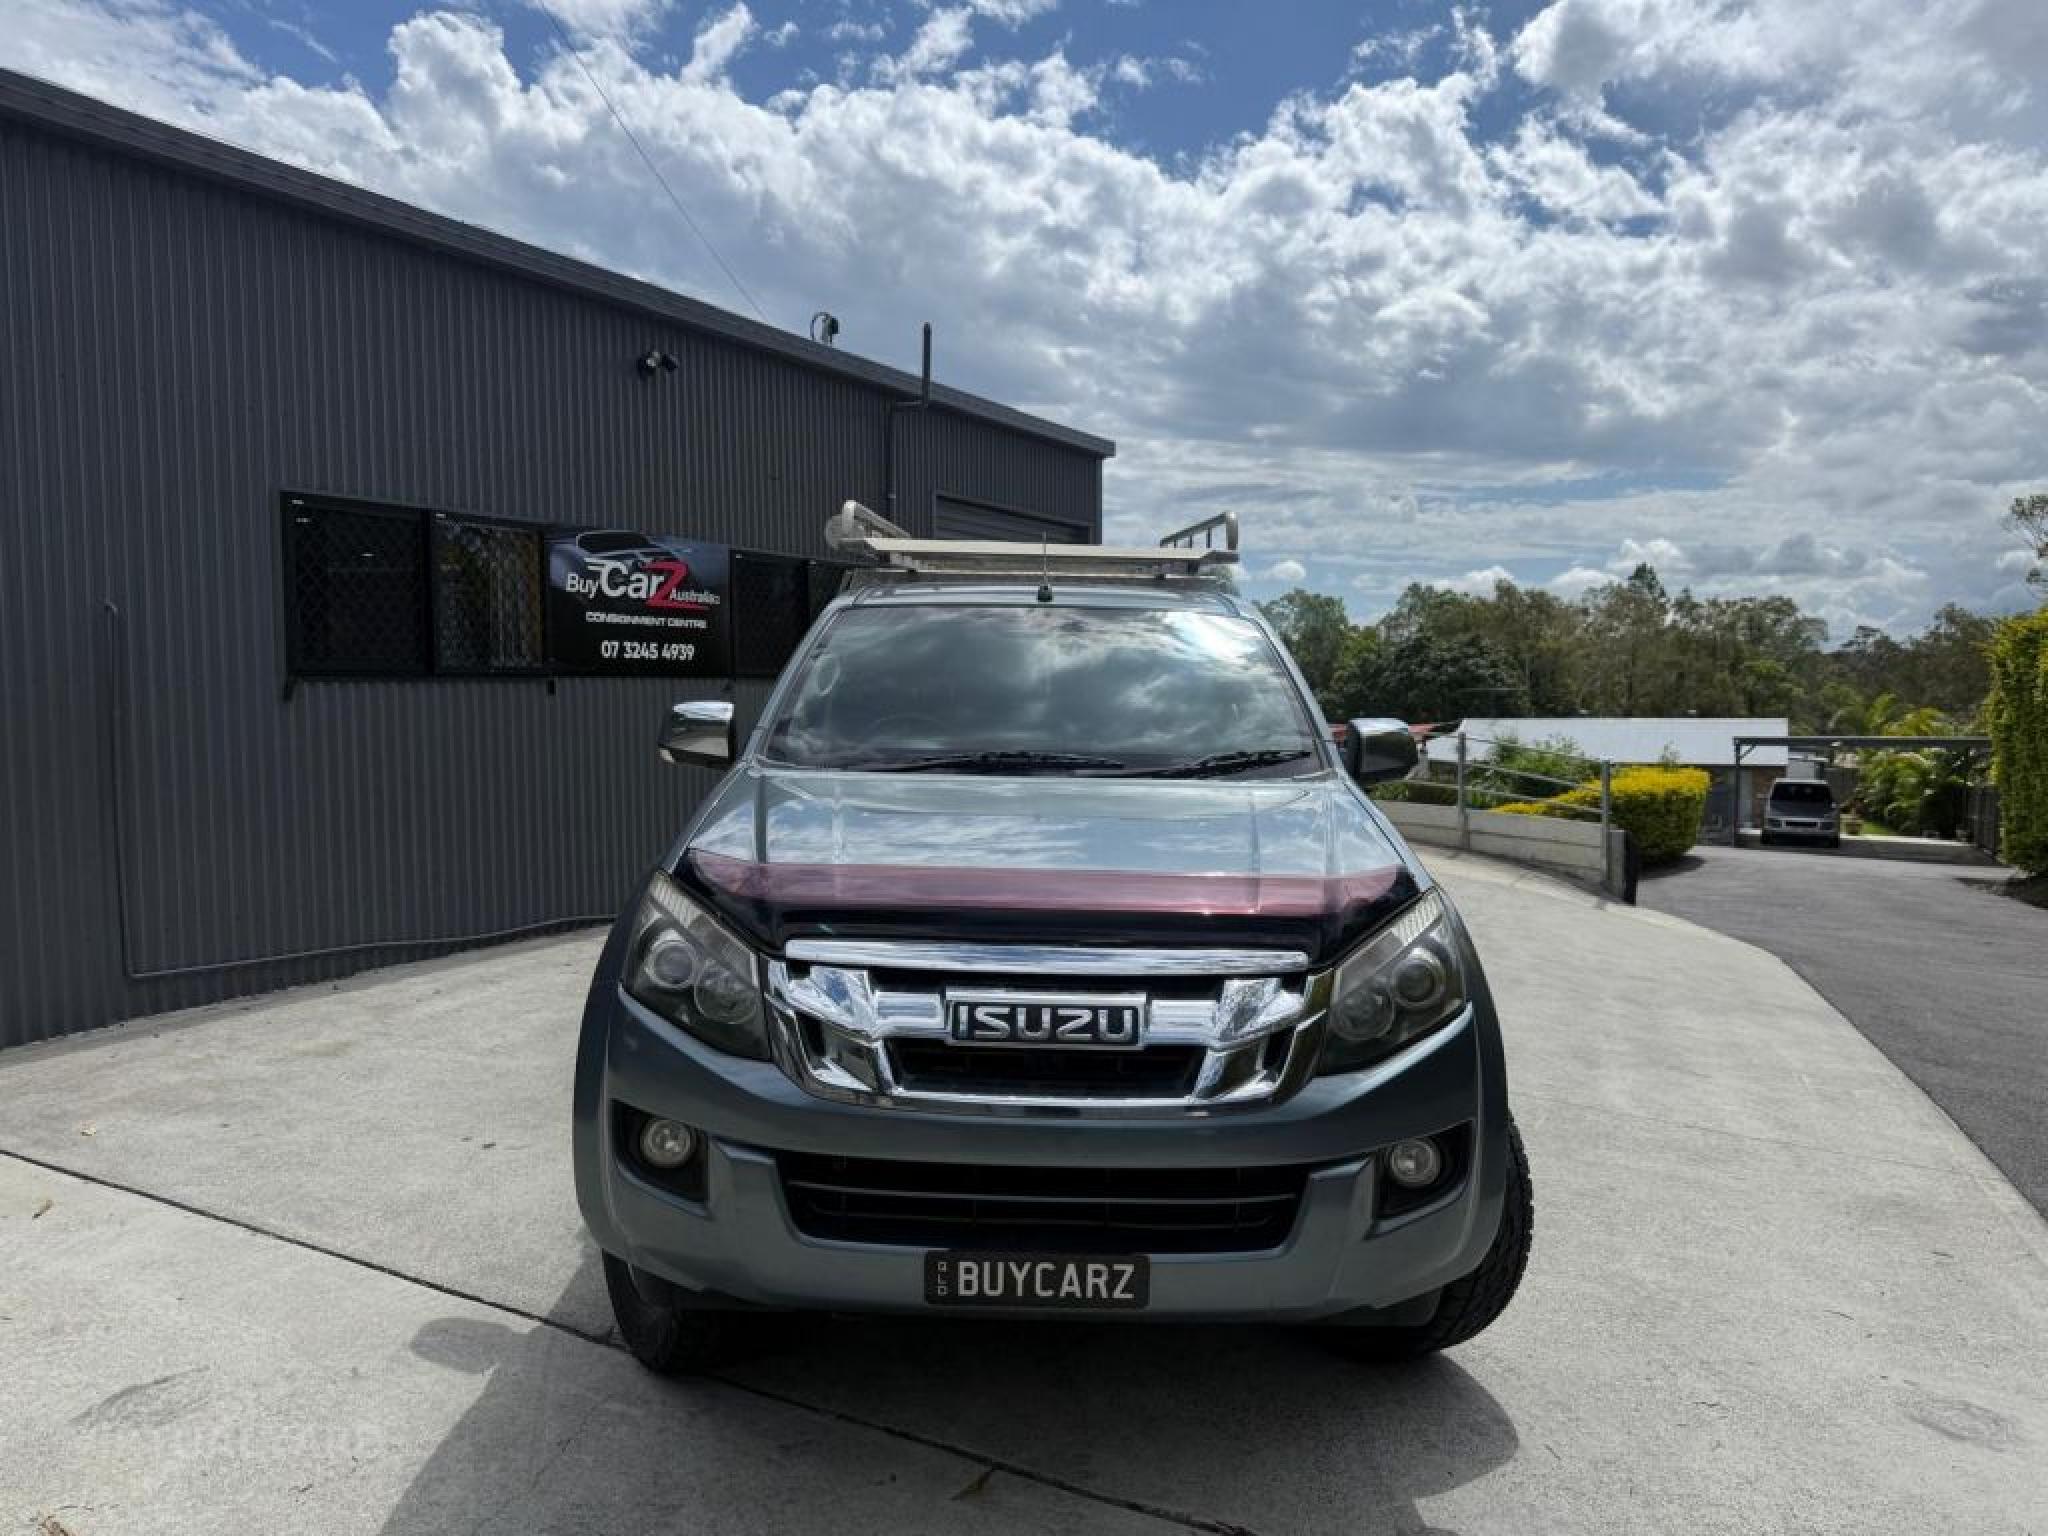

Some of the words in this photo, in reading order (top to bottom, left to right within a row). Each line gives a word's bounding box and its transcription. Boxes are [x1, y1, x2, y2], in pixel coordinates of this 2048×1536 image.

[601, 640, 619, 659] 07
[623, 641, 659, 660] 3245
[661, 643, 695, 661] 4939
[958, 1005, 1134, 1041] ISUZU
[957, 1261, 1135, 1299] BUYCARZ
